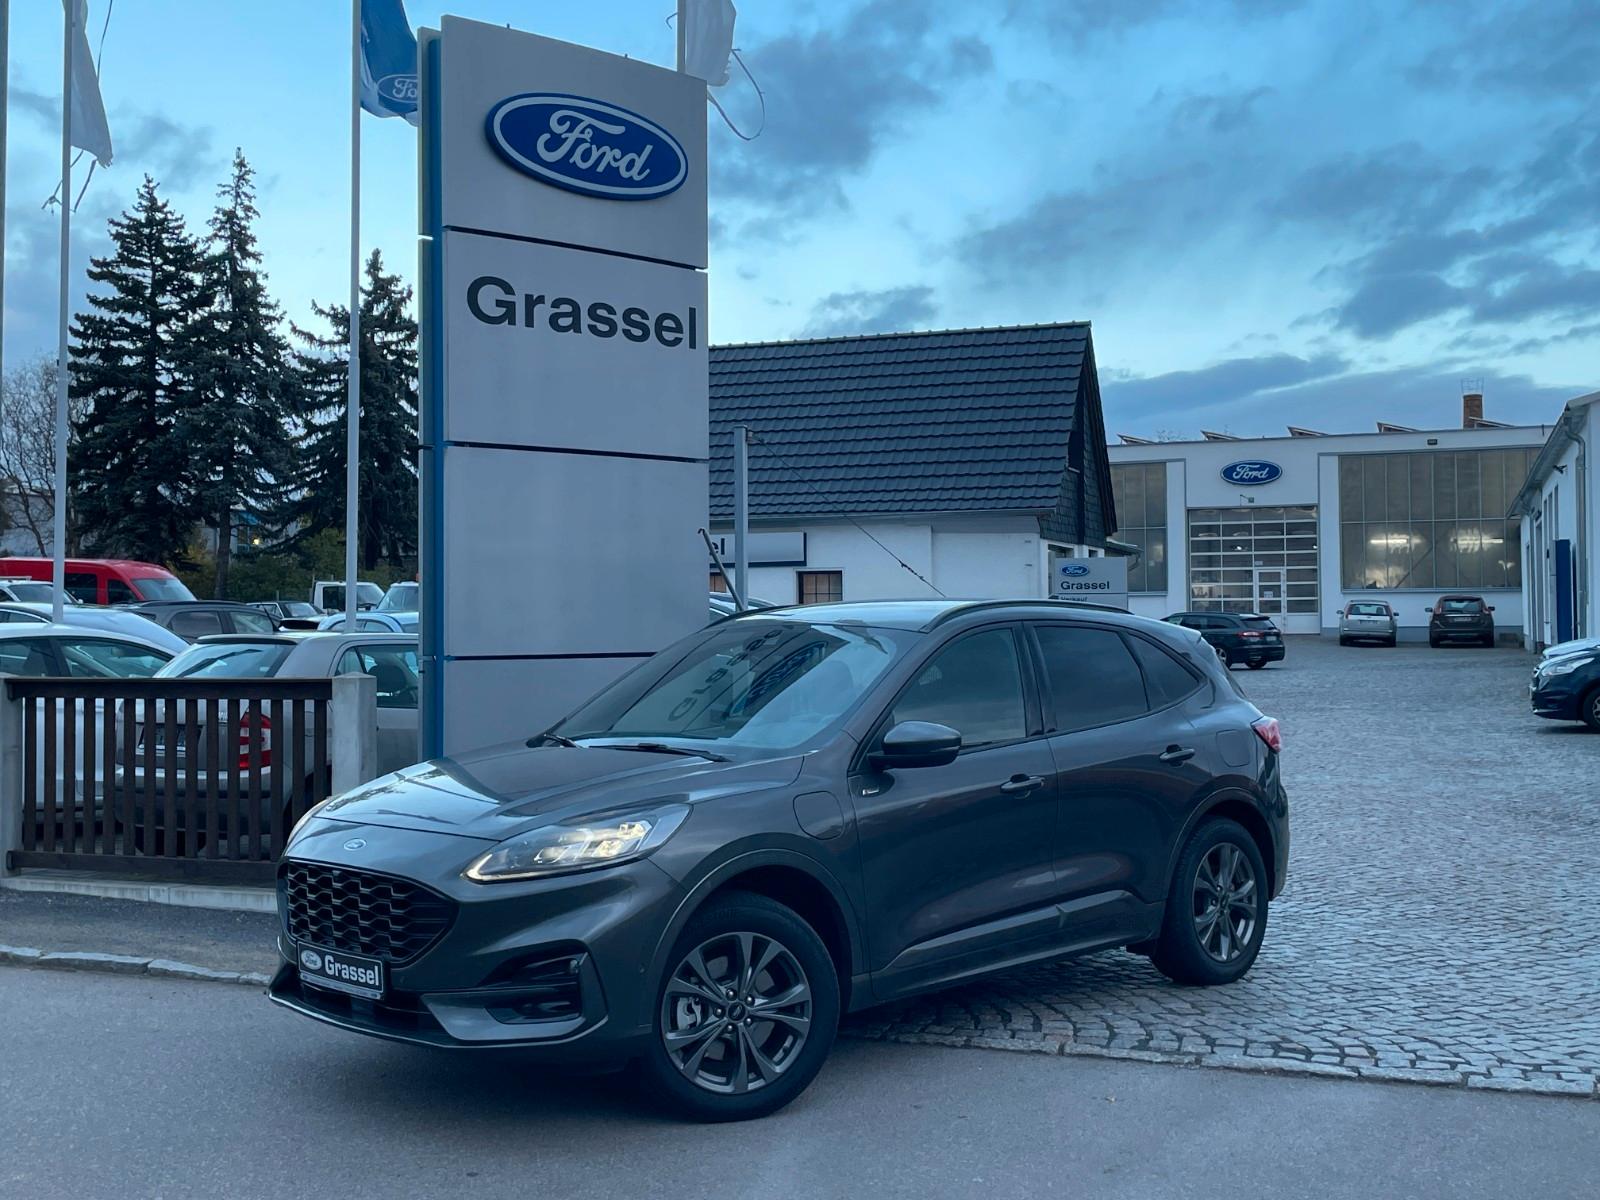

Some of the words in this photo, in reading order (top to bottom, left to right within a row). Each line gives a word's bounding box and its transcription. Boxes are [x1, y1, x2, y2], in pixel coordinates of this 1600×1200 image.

[393, 78, 417, 97] Fo
[537, 110, 653, 181] Ford
[467, 276, 697, 350] Grassel
[1233, 464, 1269, 479] Ford
[1060, 581, 1110, 590] Grassel
[324, 954, 379, 986] Grassel
